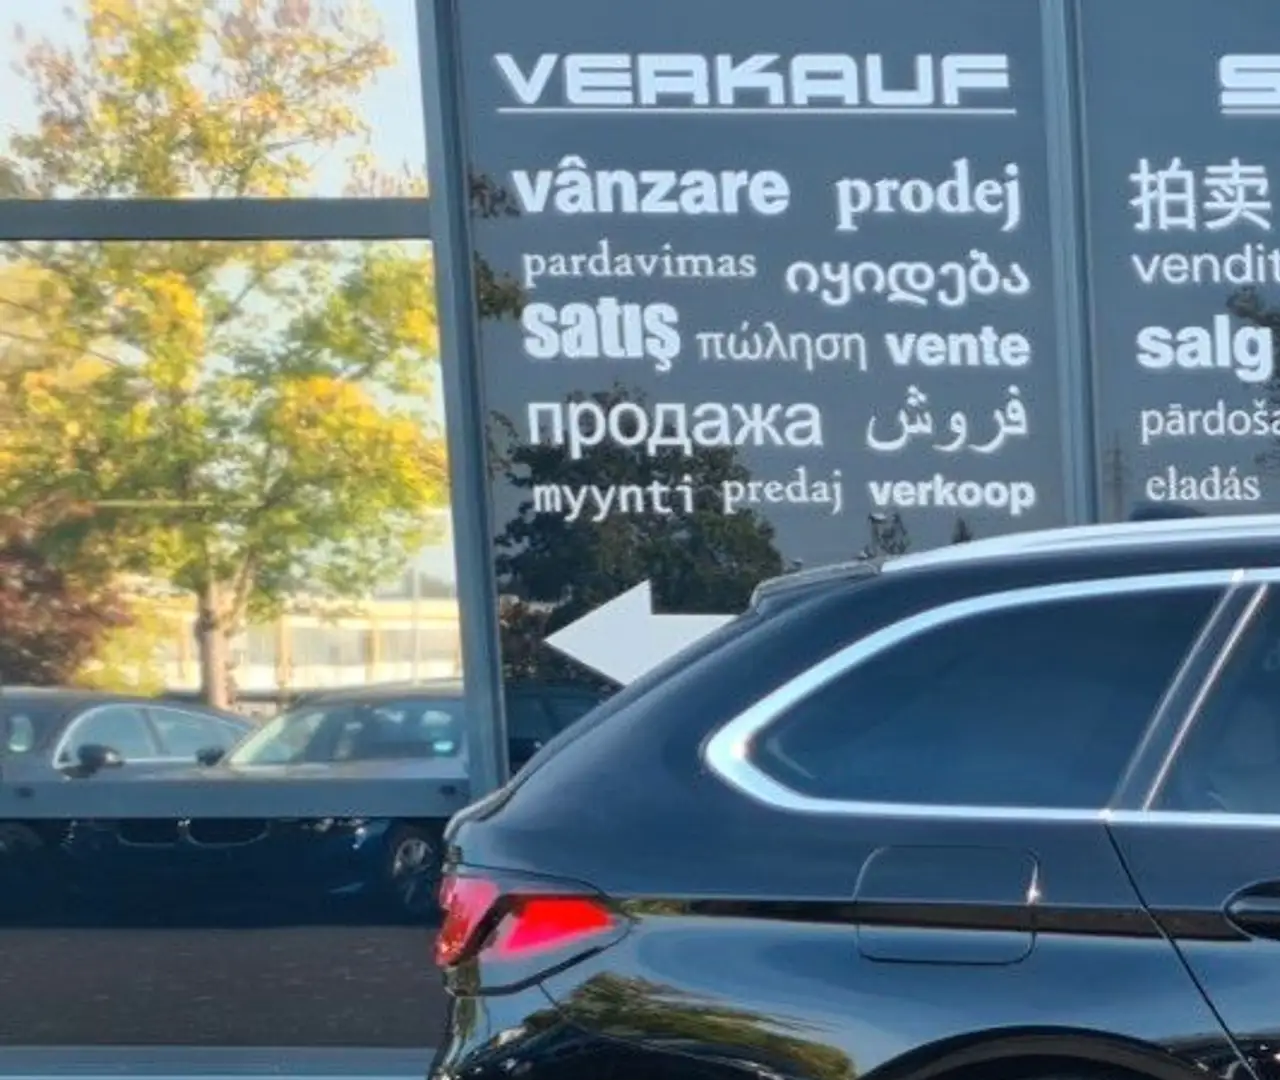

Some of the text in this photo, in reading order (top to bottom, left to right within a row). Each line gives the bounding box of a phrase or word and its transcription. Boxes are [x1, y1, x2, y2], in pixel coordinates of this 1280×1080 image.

[494, 53, 1009, 106] VERKAUF
[511, 155, 1021, 232] vânzare prodej
[1129, 157, 1272, 231] 拍卖
[523, 239, 757, 289] pardavimas
[785, 249, 1030, 307] იყიდება
[522, 297, 681, 372] satış
[695, 321, 868, 371] πώληση
[885, 325, 1031, 367] vente
[1136, 314, 1273, 382] salg
[527, 401, 824, 460] продажа
[866, 385, 1028, 454] فروش
[532, 466, 1036, 522] myynti predaj verkoop
[1146, 465, 1261, 501] eladás
